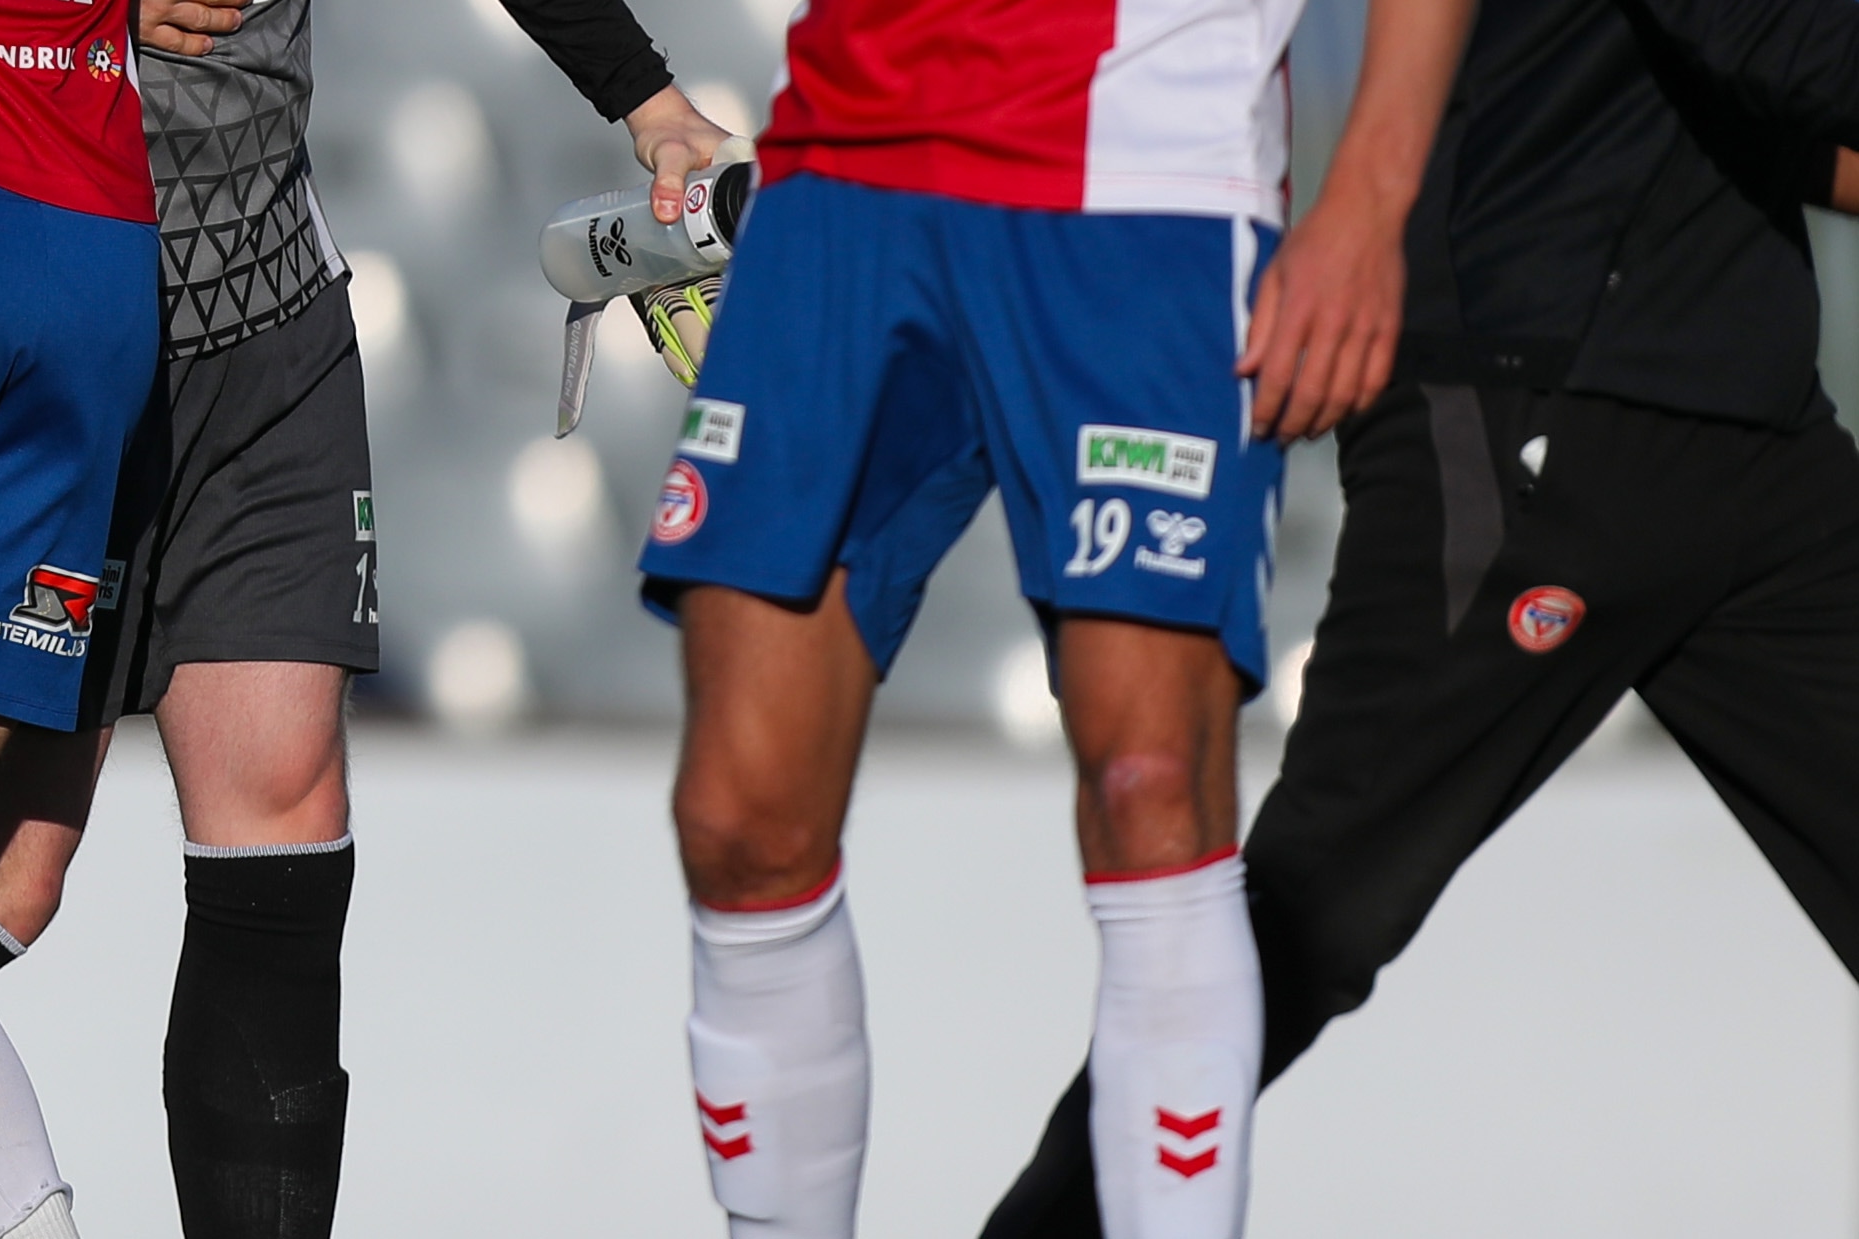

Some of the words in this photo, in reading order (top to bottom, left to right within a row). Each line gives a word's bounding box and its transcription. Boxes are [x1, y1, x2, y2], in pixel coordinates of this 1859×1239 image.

[589, 217, 613, 278] hummel
[696, 233, 717, 249] 1
[1088, 434, 1166, 474] KIWI
[1063, 497, 1132, 579] 19
